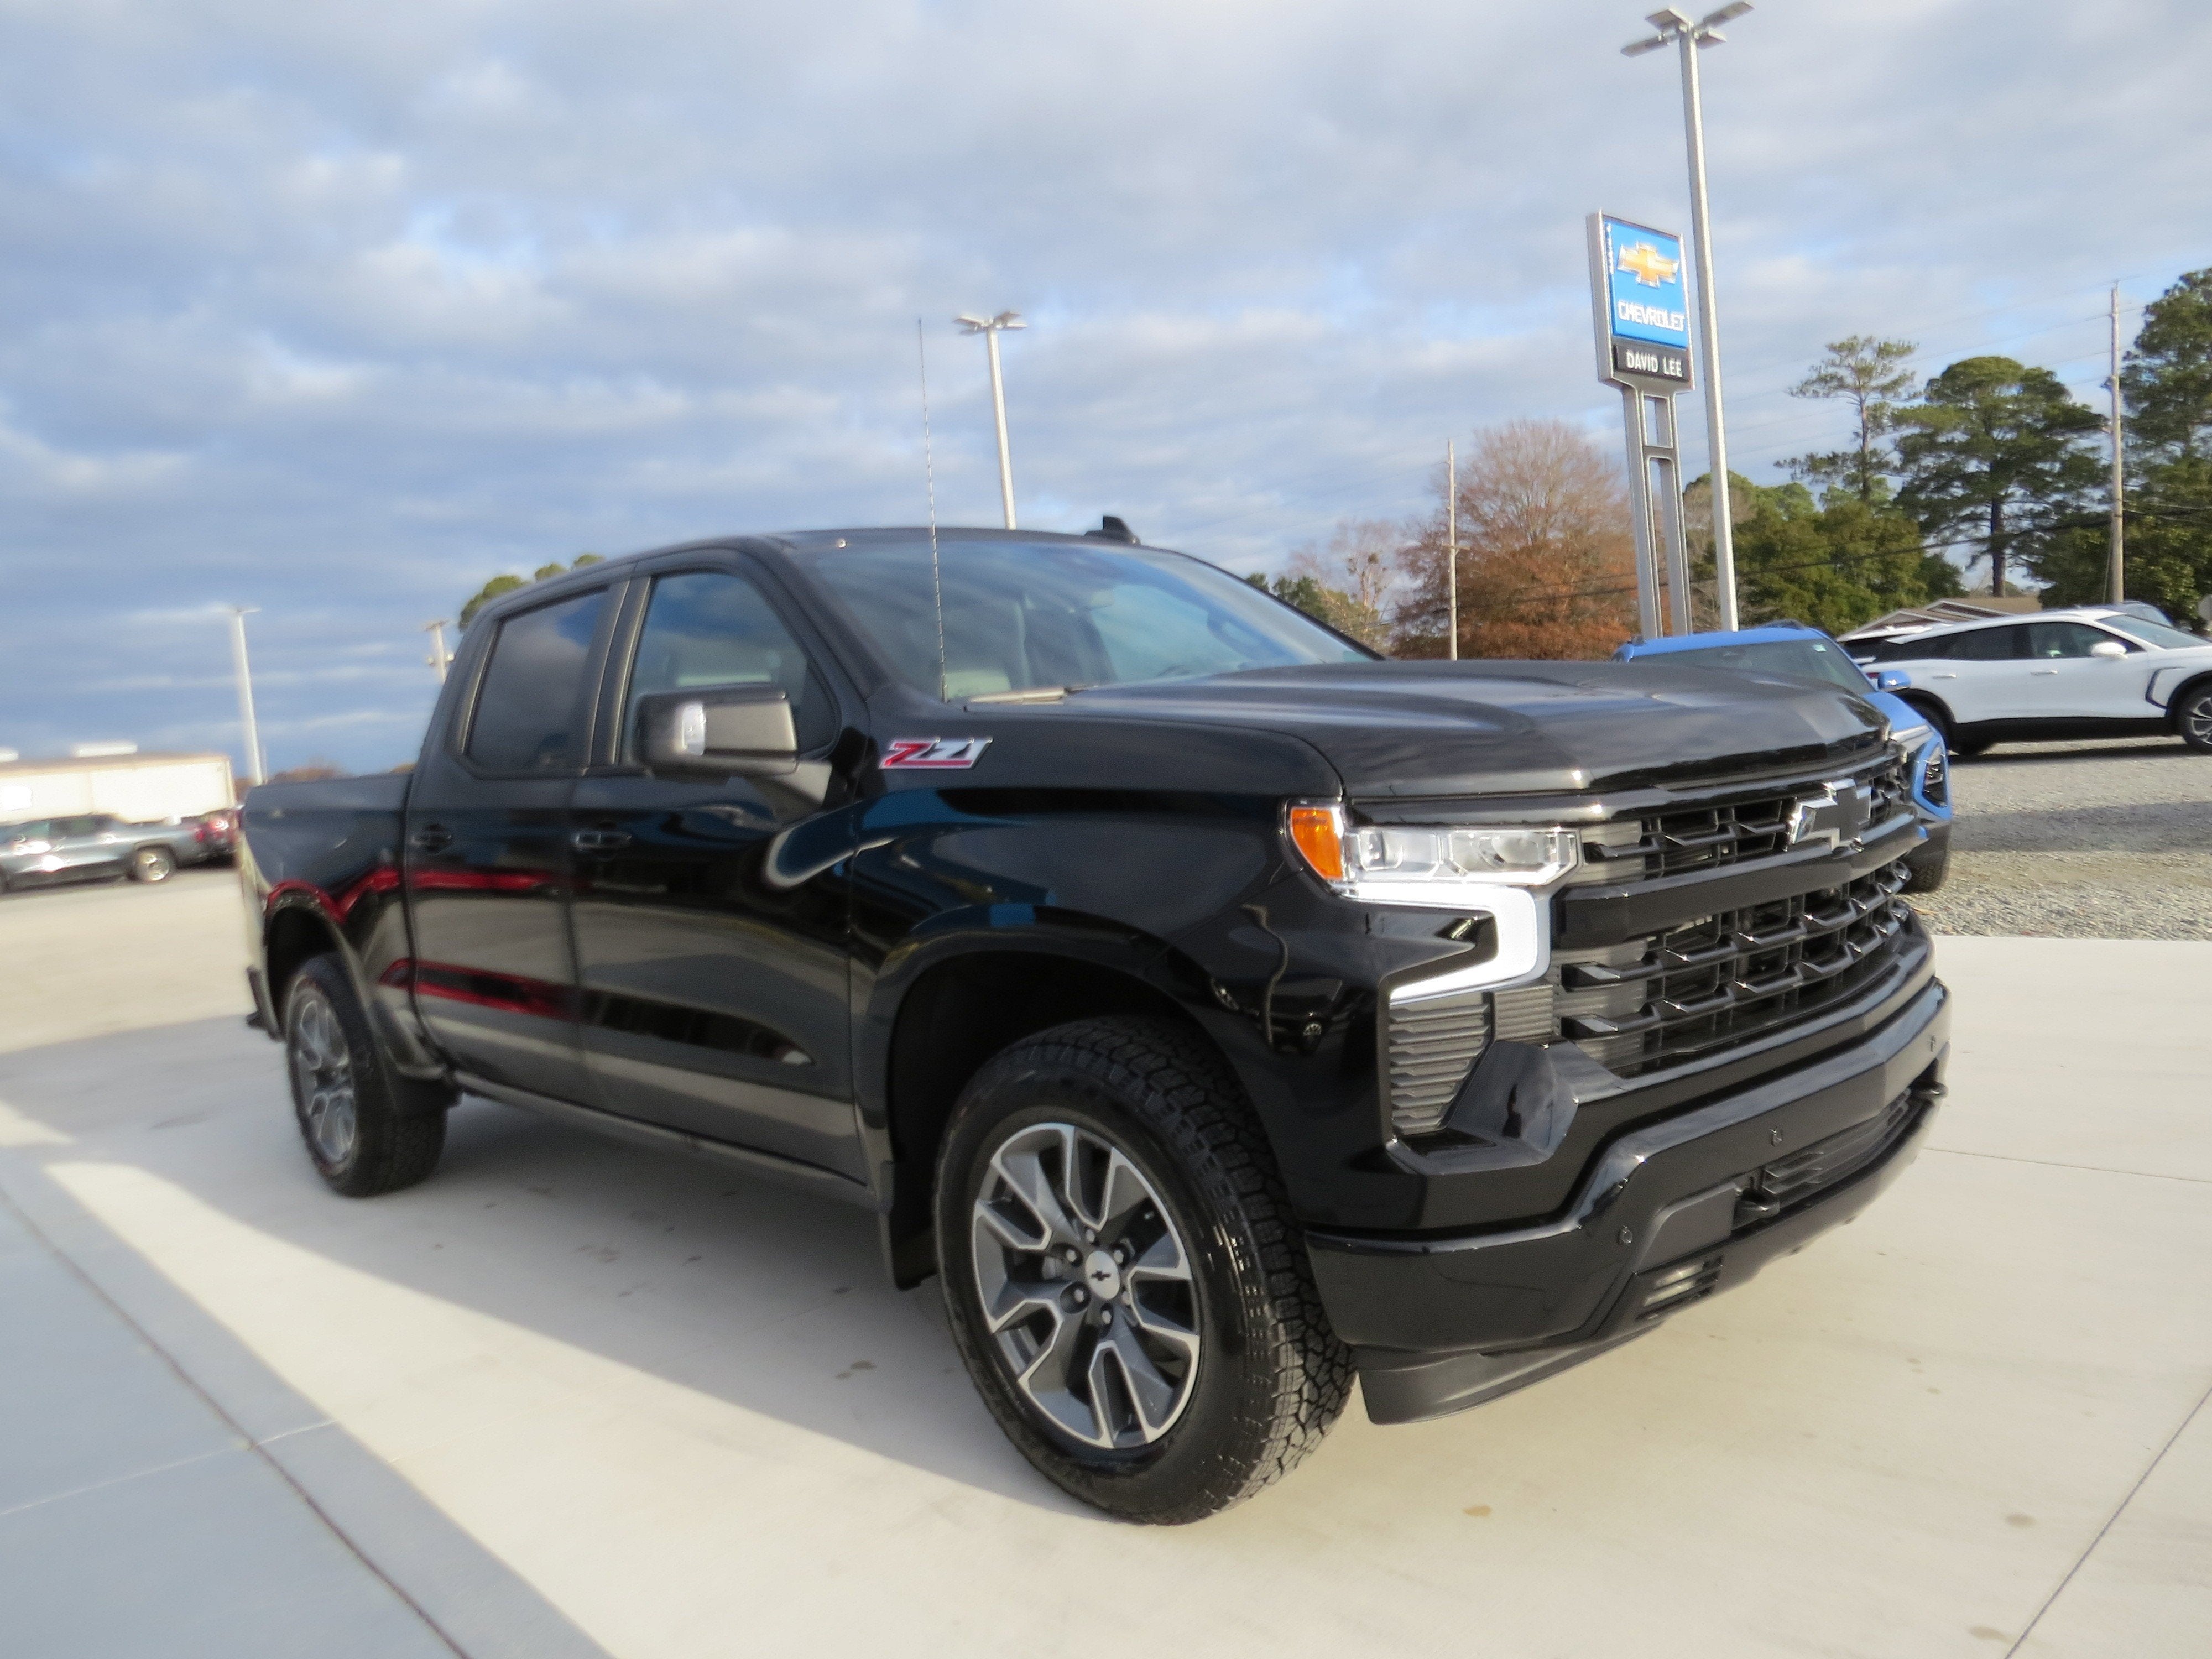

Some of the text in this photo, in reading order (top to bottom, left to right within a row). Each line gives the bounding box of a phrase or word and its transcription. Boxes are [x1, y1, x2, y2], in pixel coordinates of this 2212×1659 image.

[1618, 301, 1684, 332] CHEVROLET
[1625, 349, 1683, 378] DAVID LEE
[878, 737, 994, 769] Z71
